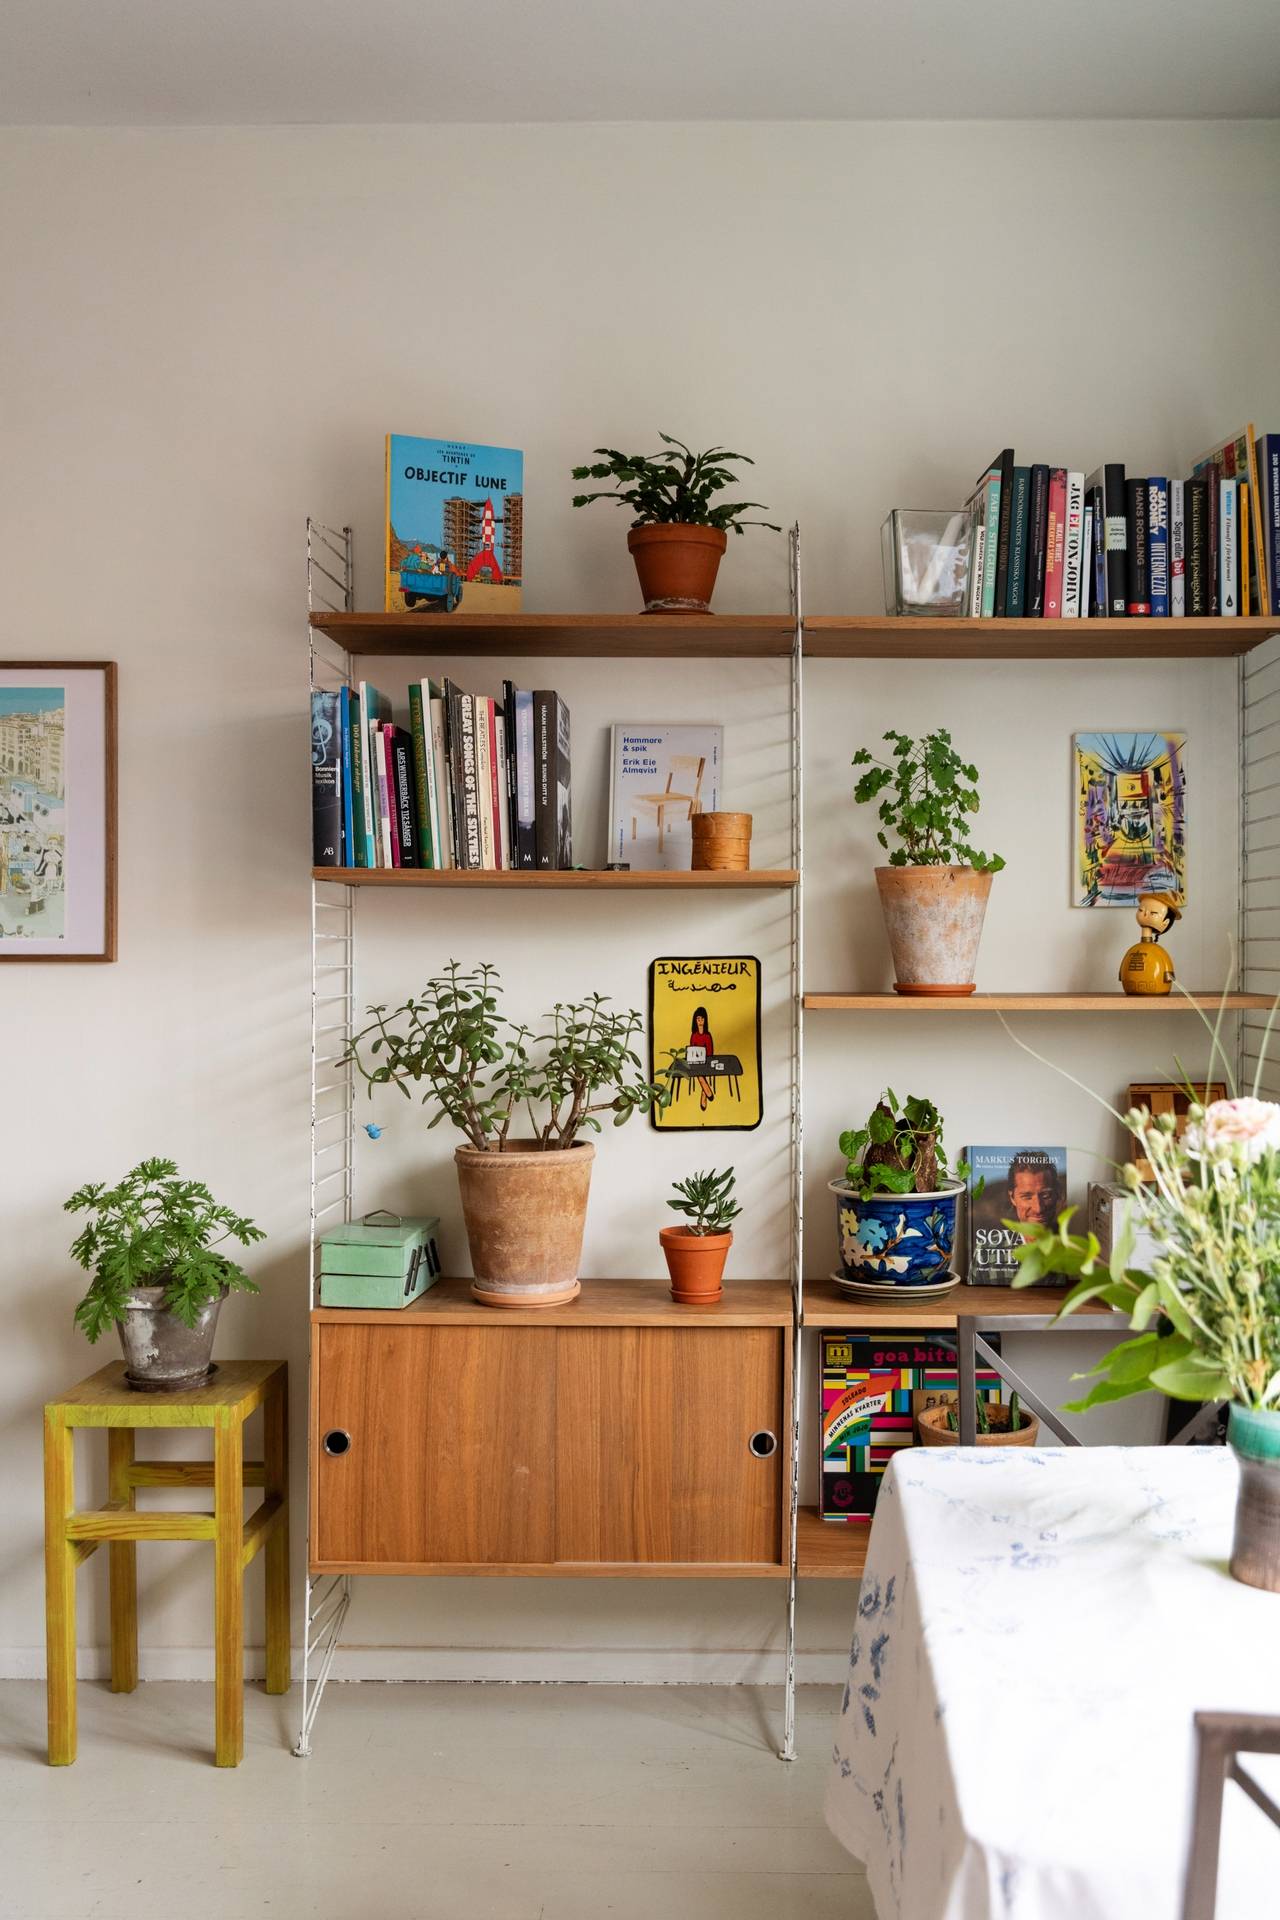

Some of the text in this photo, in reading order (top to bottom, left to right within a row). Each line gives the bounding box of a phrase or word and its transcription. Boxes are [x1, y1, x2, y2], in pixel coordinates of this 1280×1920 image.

[442, 455, 470, 465] TINTIN
[404, 466, 507, 490] OBJECTIF LUNE
[990, 493, 999, 513] FAB
[1135, 487, 1145, 517] HANS
[1149, 485, 1158, 536] ROONEY
[1158, 490, 1166, 529] SALLY
[1011, 478, 1025, 605] BARNDOMSLANDETS KLASSISKA SAGOR
[1066, 483, 1081, 604] JAG ELTON JOHN
[1135, 519, 1145, 566] ROSLING
[1173, 521, 1184, 574] Segra eller dö
[1190, 486, 1203, 612] Matematisk uppslagsbok
[985, 531, 997, 588] STILGUIDE
[1151, 543, 1166, 595] INTERMEZZO
[1210, 595, 1218, 610] 2
[411, 698, 421, 730] STORA
[352, 723, 361, 737] 100
[541, 726, 549, 759] HELLSTRÖM
[623, 736, 663, 744] Hammare
[397, 747, 406, 764] LARS
[623, 758, 640, 766] Erik
[631, 745, 647, 753] spik
[399, 764, 410, 809] WINNERBÄCK
[461, 695, 479, 864] GREAT SONGS OF THE SIXTIES
[402, 810, 410, 821] 112
[402, 821, 412, 847] SÅNGER
[975, 1155, 1060, 1164] MARKUS TORGEBY
[975, 1228, 1026, 1246] SOVA
[872, 1349, 909, 1366] goa
[841, 1386, 867, 1406] SOLEADO
[828, 1399, 882, 1438] MINNENAS KVARTER
